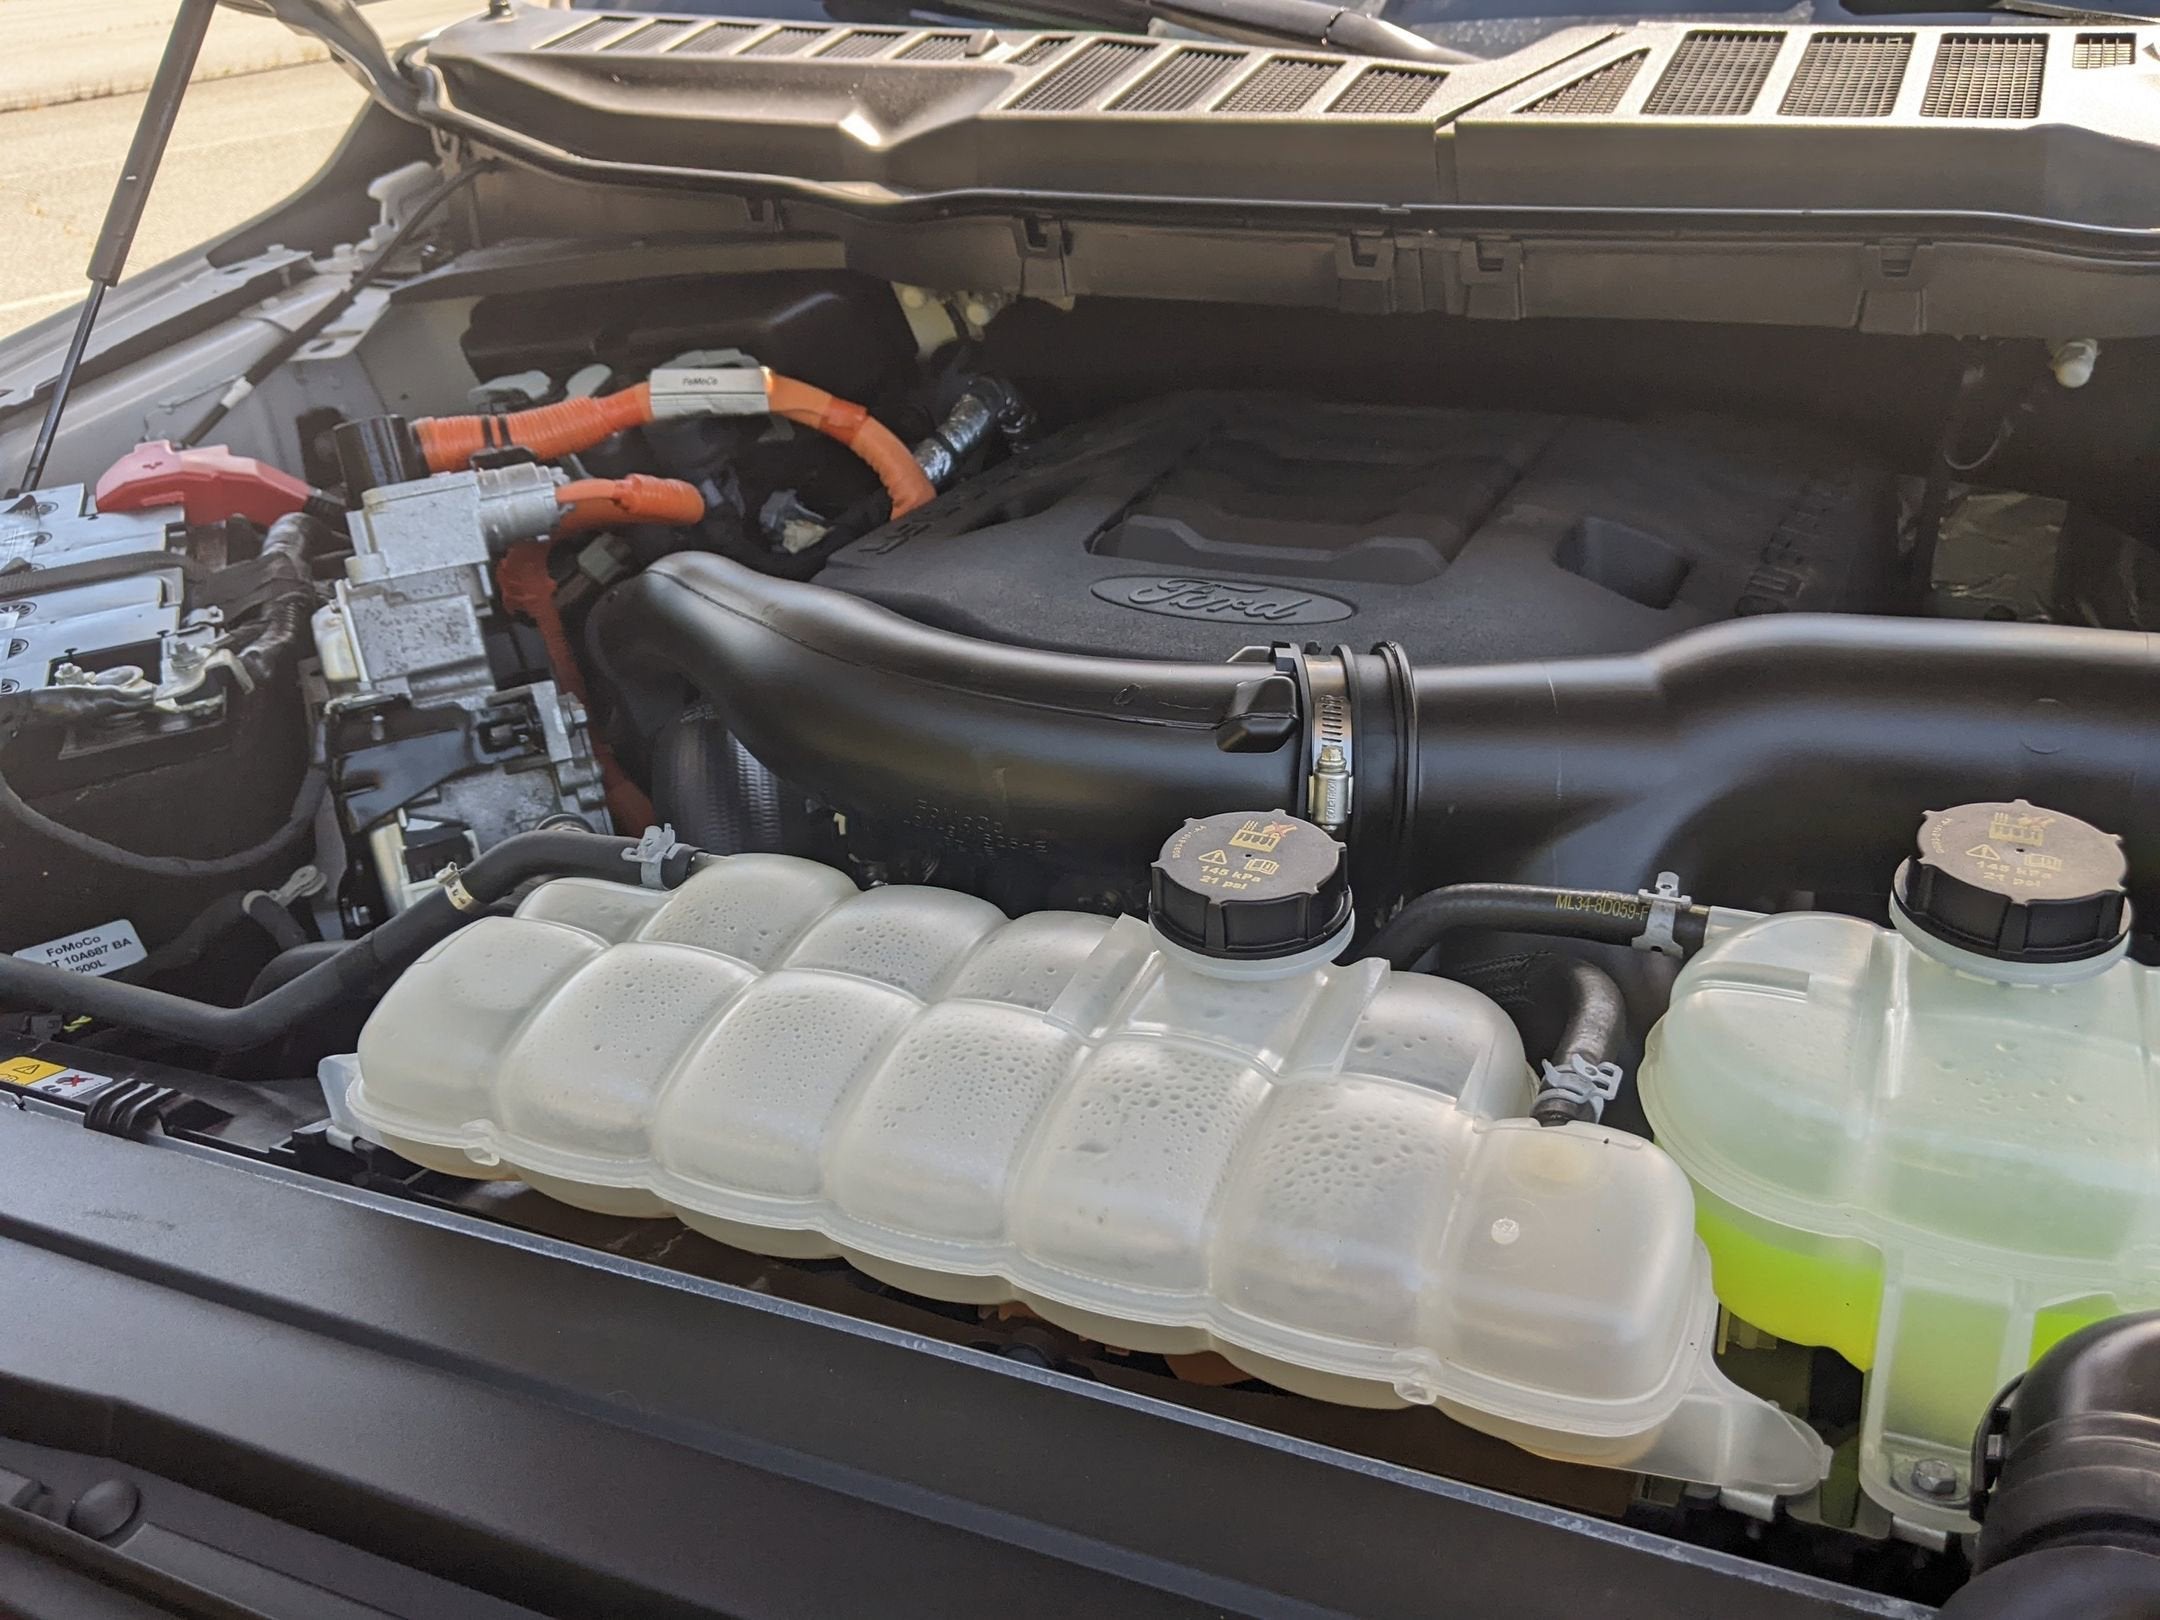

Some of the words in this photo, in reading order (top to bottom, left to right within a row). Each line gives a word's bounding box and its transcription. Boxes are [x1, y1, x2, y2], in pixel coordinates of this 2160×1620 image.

[1128, 579, 1313, 620] Ford
[1200, 875, 1219, 884] 21
[1222, 881, 1248, 890] psi
[1201, 865, 1230, 876] 145
[1232, 871, 1262, 882] kPa
[46, 935, 102, 957] FoMoCo
[64, 945, 109, 965] 10A687
[112, 937, 133, 950] BA
